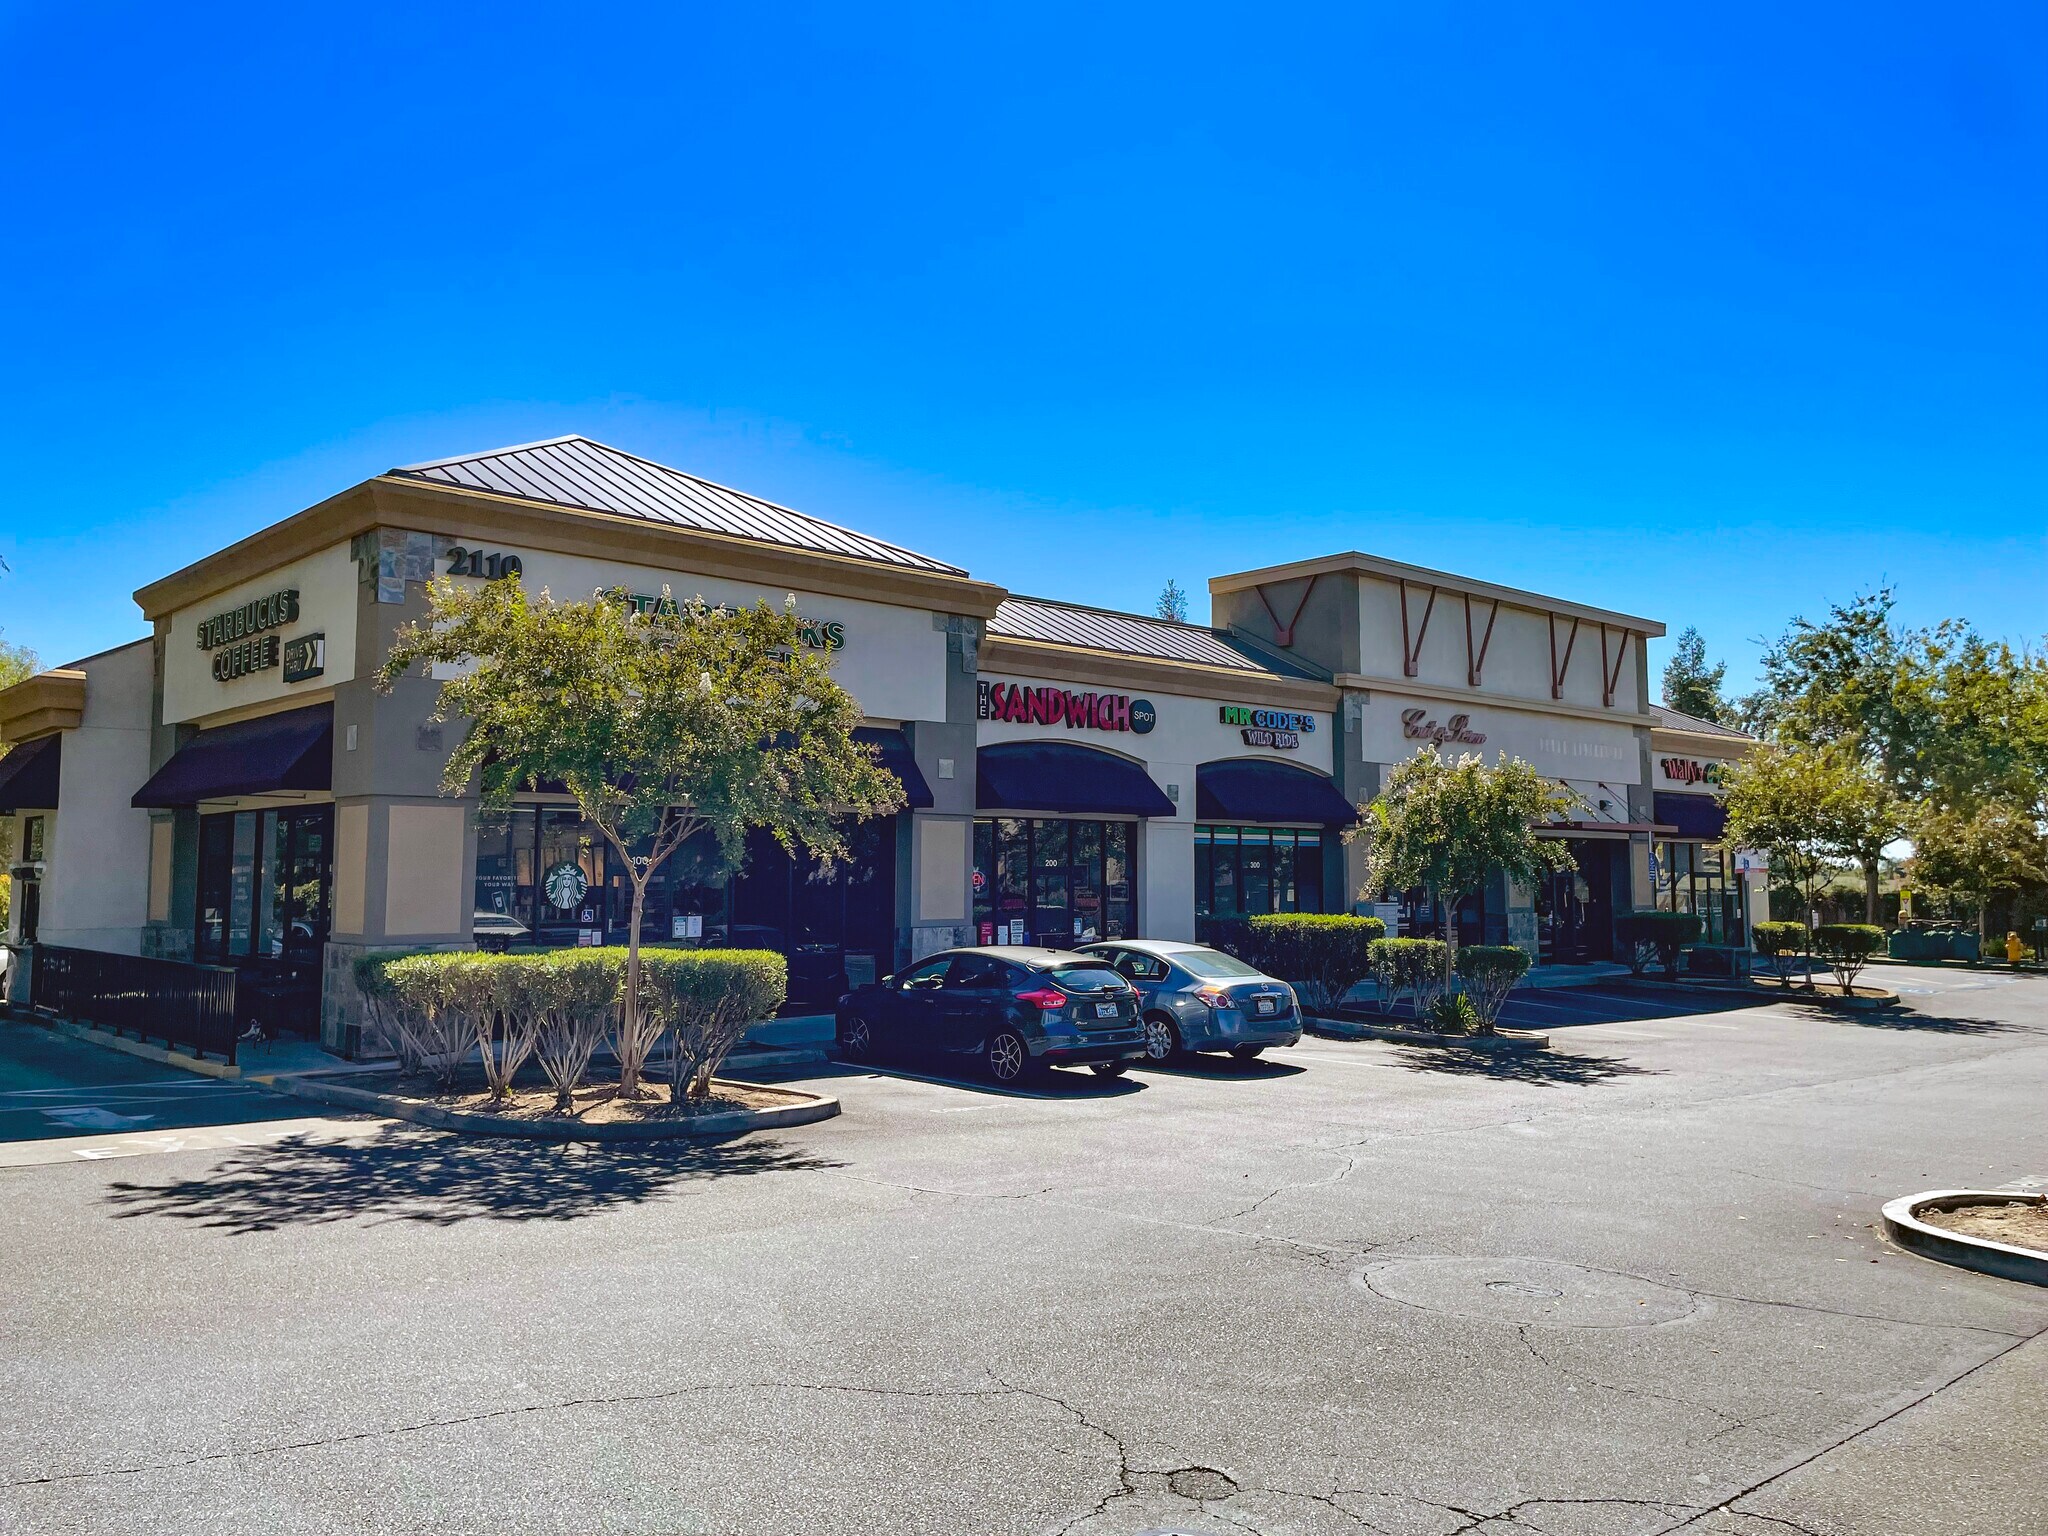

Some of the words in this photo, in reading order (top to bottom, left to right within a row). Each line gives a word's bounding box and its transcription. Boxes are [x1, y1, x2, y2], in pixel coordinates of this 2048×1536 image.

[447, 547, 522, 580] 2110
[196, 589, 297, 650] STARBUCKS
[213, 635, 278, 681] COFFEE
[286, 645, 303, 661] DRIVE
[286, 661, 302, 674] THRU
[979, 683, 987, 717] THE
[990, 682, 1129, 731] SANDWICH
[1133, 711, 1154, 722] SPOT
[1223, 706, 1252, 725] MR
[1254, 709, 1316, 732] CODE'S
[1246, 730, 1273, 745] WILD
[1274, 732, 1298, 748] RIDE
[1662, 758, 1704, 785] Wally's
[1045, 859, 1057, 867] 200
[1250, 861, 1260, 869] 300
